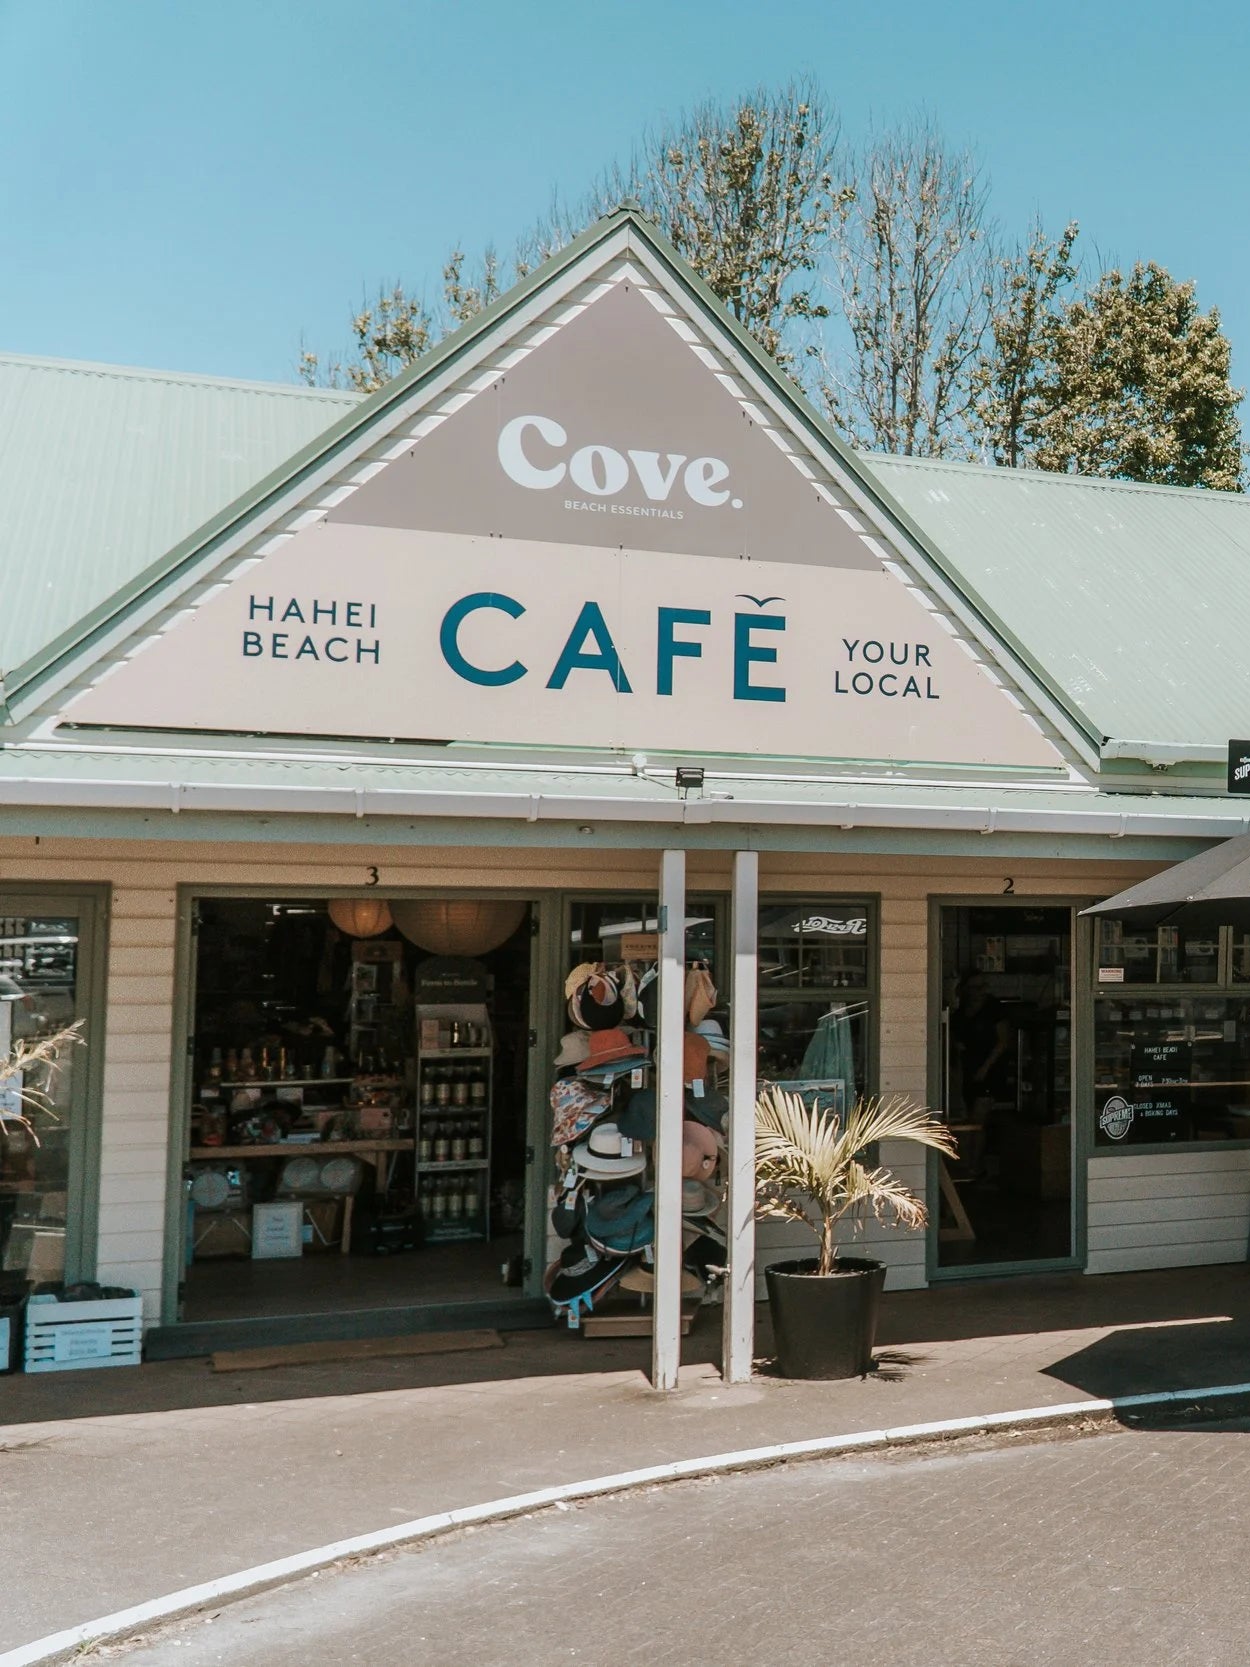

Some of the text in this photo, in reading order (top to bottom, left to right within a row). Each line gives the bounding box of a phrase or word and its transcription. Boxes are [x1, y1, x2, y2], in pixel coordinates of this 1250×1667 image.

[498, 414, 743, 509] Cove.
[564, 499, 684, 520] BEACH ESSENTIALS
[248, 594, 378, 629] HAHEI
[242, 630, 381, 665] BEACH
[842, 638, 931, 668] YOUR
[834, 670, 940, 700] LOCAL
[365, 866, 379, 886] 3
[1003, 877, 1015, 894] 2
